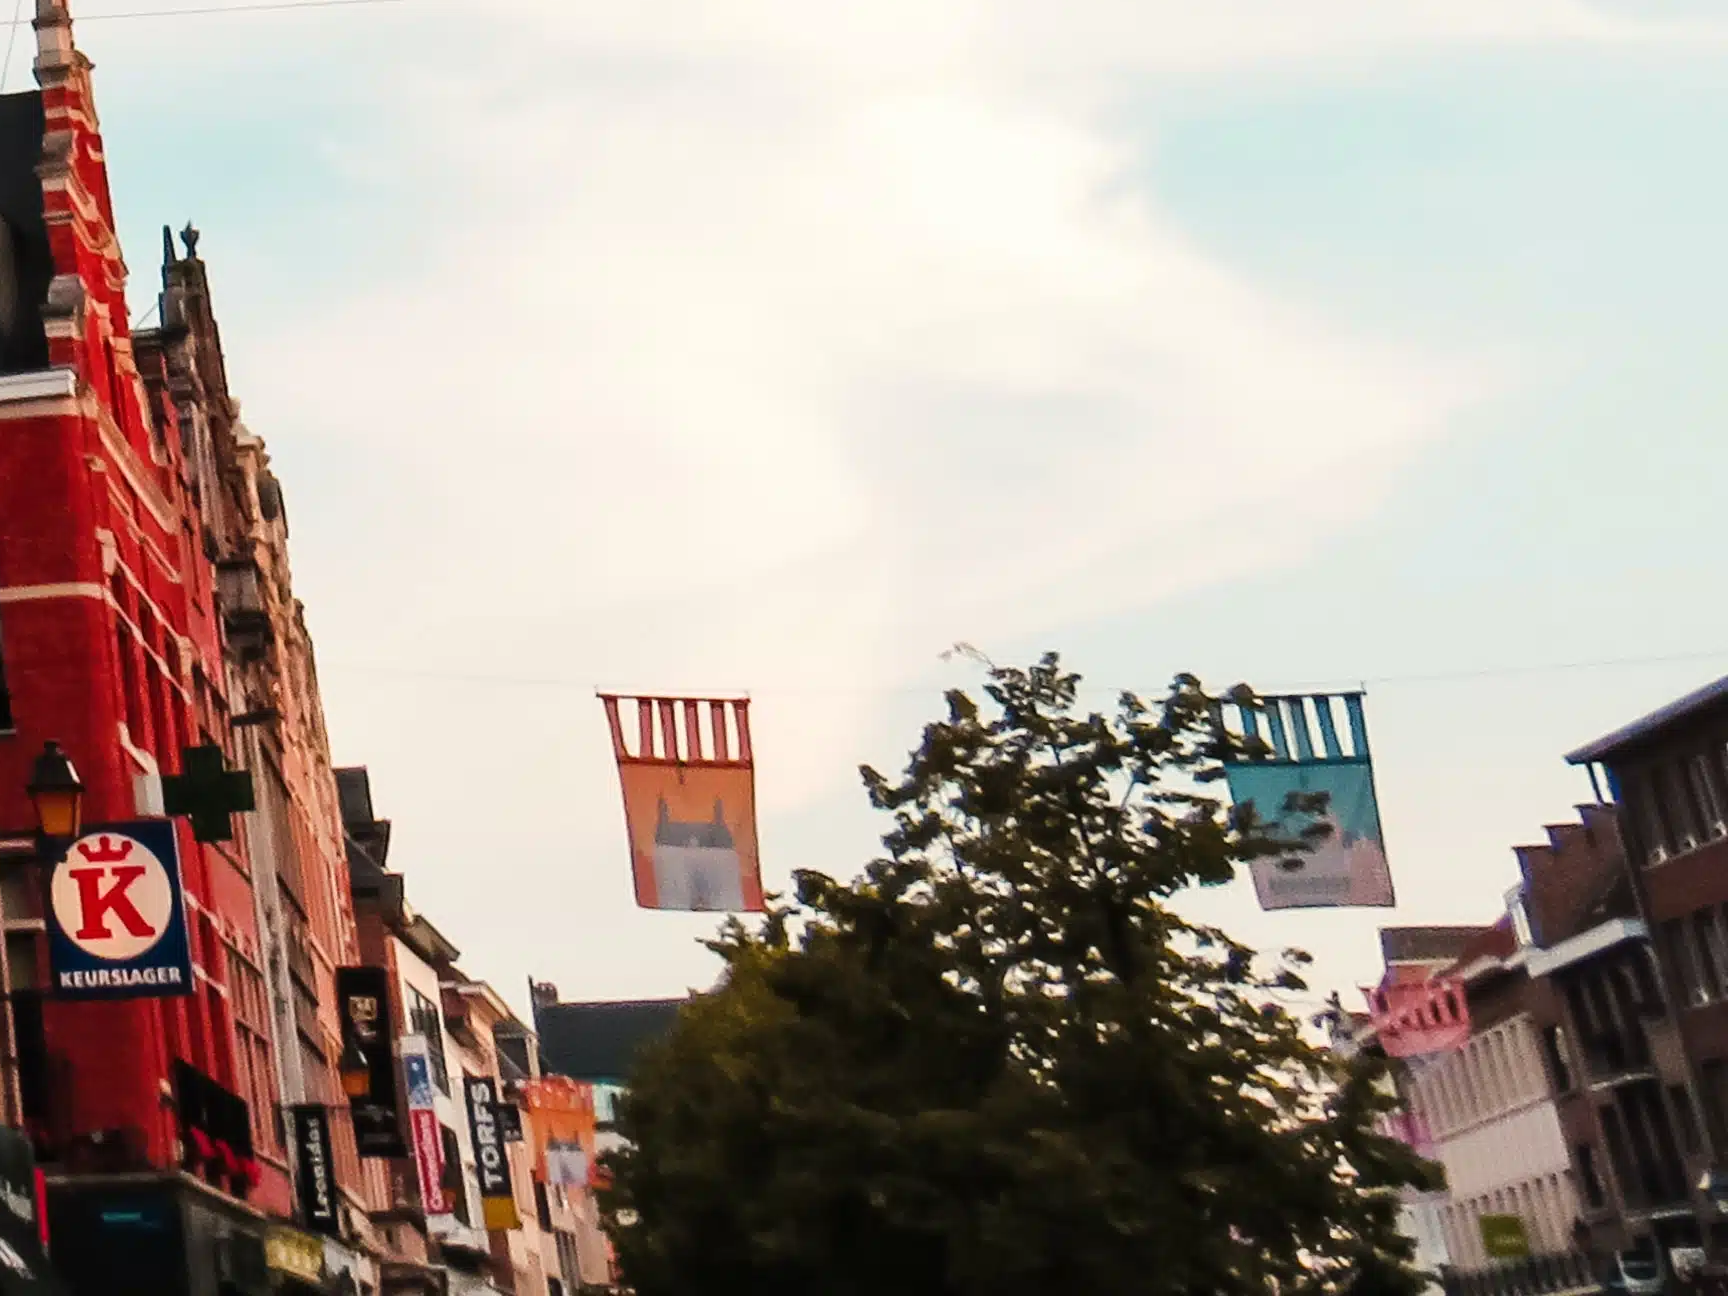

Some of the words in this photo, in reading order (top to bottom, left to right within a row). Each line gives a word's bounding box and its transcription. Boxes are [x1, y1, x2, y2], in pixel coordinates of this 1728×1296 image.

[69, 865, 156, 940] K
[59, 966, 182, 988] KEURSLAGER
[471, 1082, 504, 1190] TORFS
